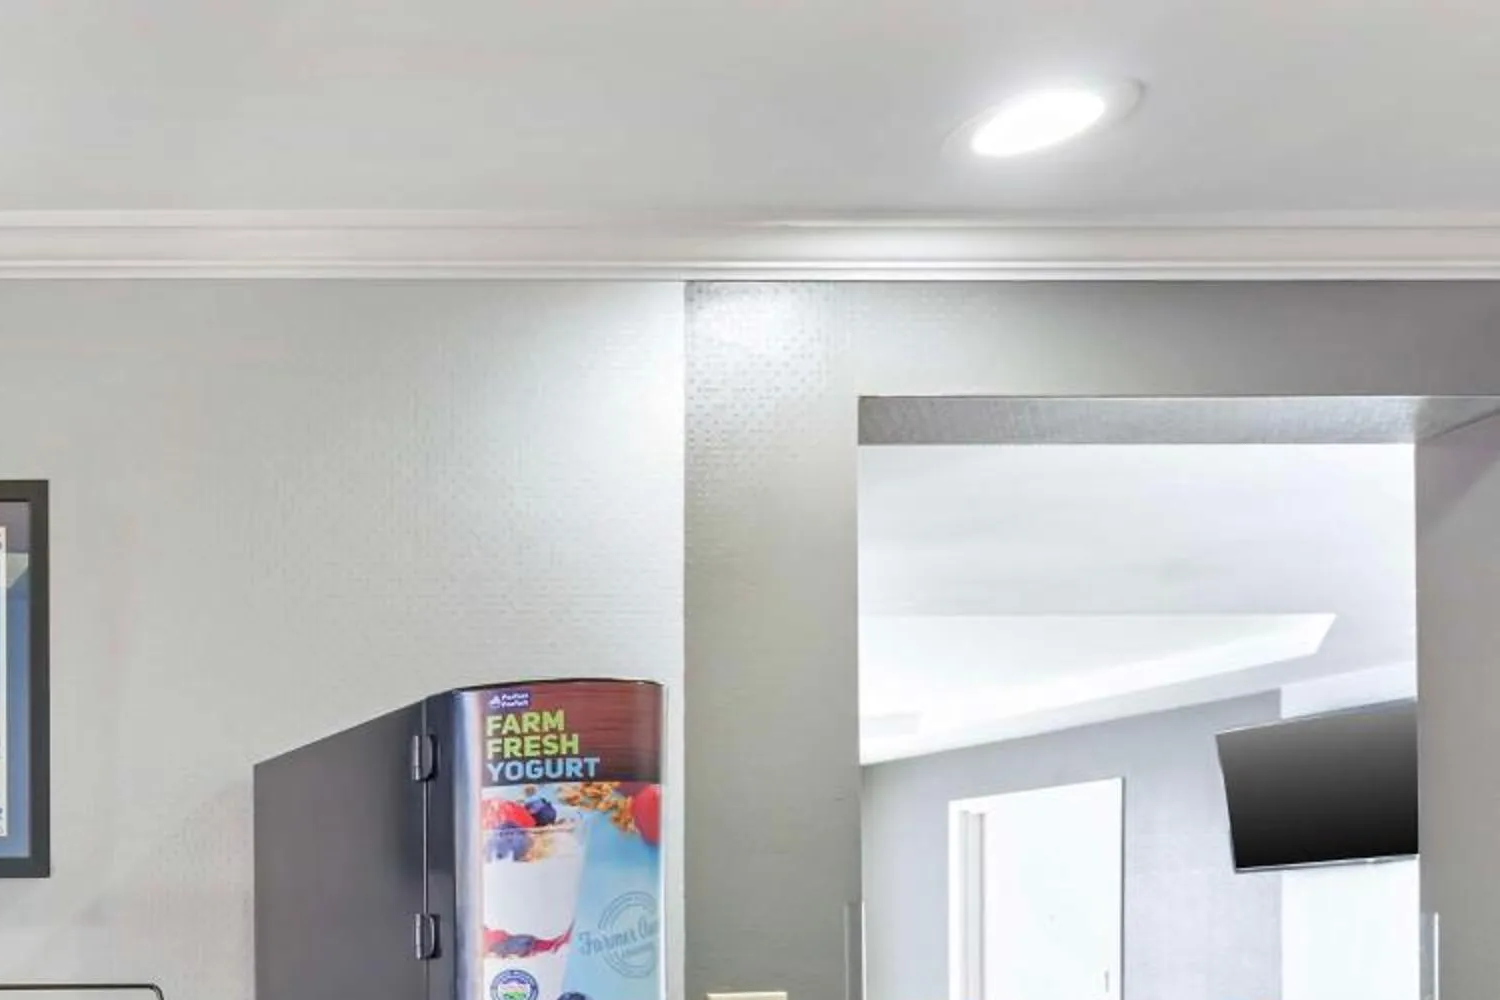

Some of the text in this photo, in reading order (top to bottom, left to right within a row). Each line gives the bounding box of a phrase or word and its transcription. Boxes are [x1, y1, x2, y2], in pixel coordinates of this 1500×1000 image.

[486, 709, 565, 737] FARM
[487, 733, 579, 759] FRESH
[486, 757, 601, 782] YOGURT
